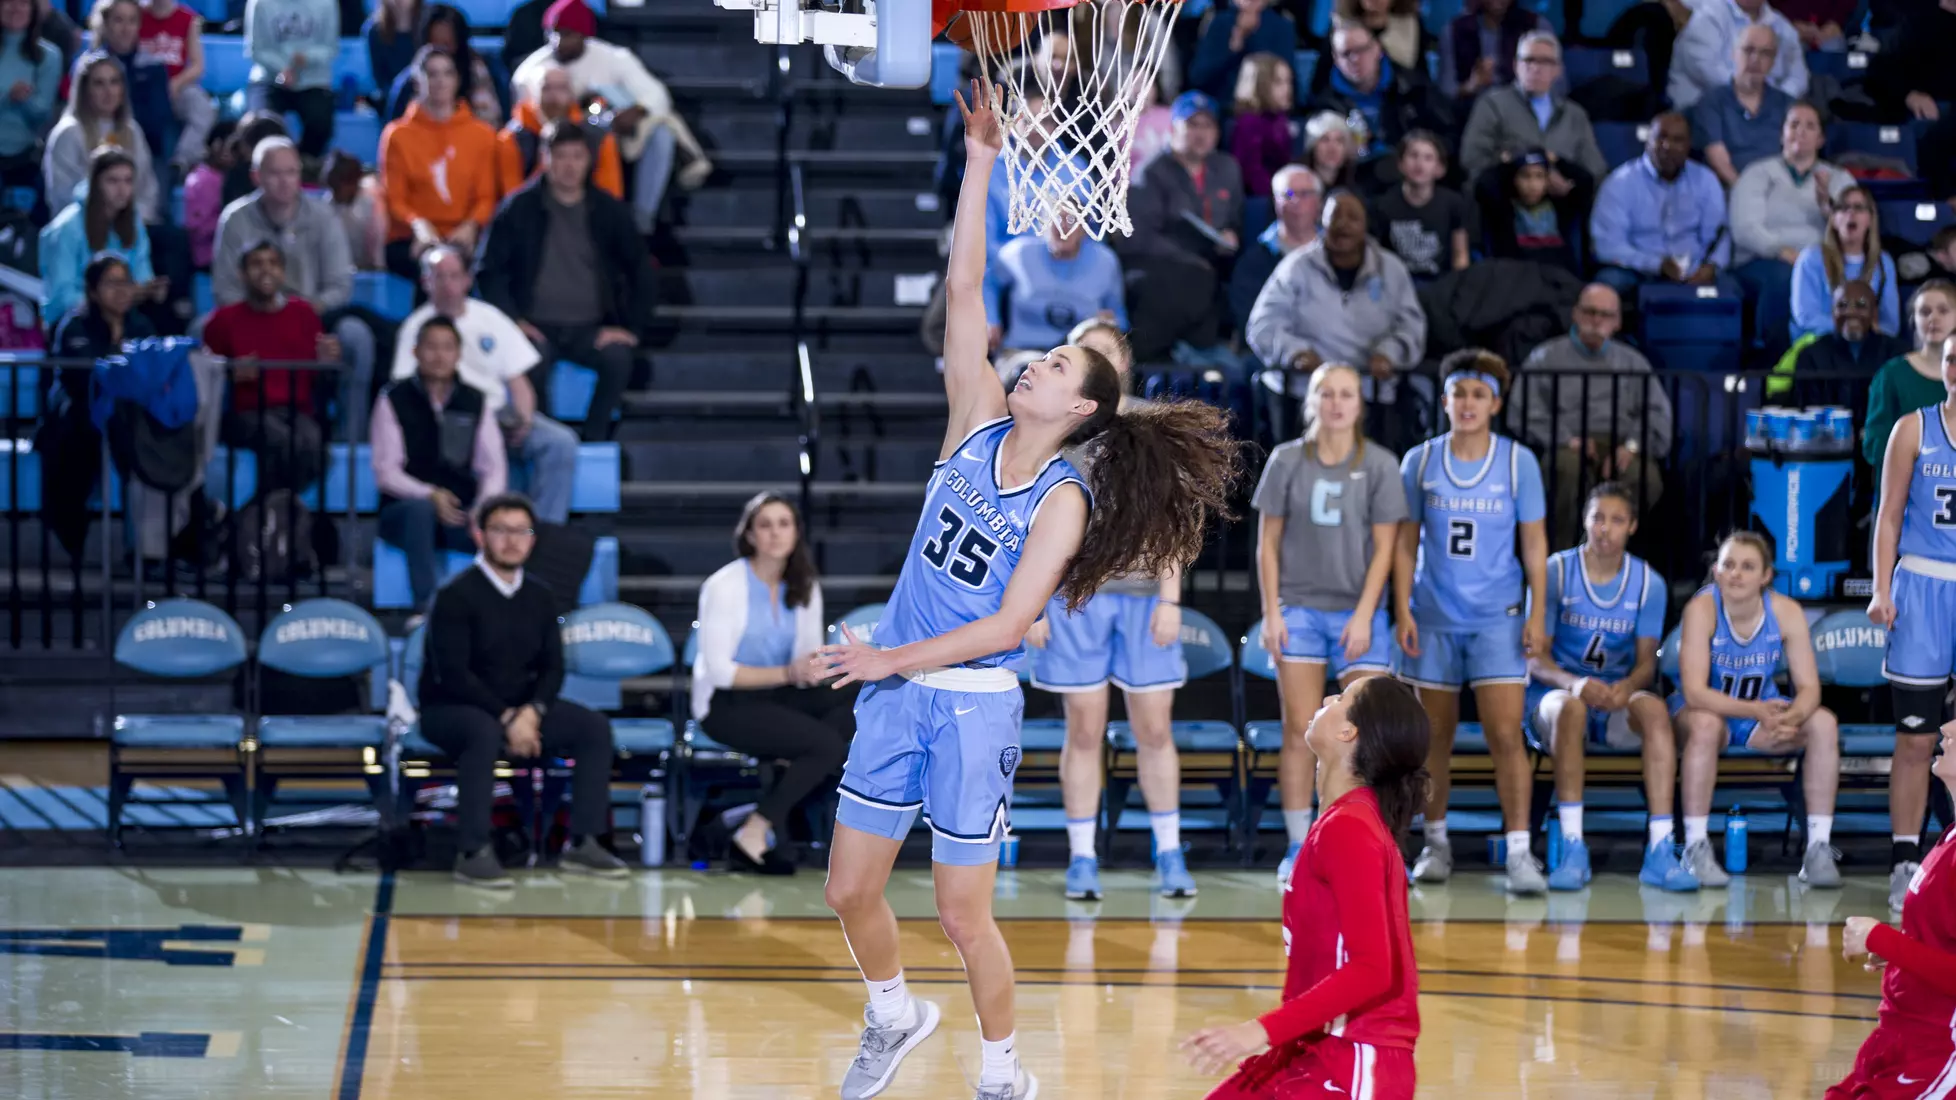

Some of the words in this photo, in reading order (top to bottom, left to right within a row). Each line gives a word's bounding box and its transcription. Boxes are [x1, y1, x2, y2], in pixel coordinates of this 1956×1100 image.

[1922, 463, 1956, 478] COL
[945, 468, 1021, 552] COLUMBIA
[1310, 478, 1342, 526] C
[920, 502, 1000, 589] 35
[1446, 516, 1476, 560] 2
[134, 616, 227, 642] COLUMBIA
[276, 616, 369, 643] COLUMBIA
[562, 619, 654, 645] COLUMBIA
[1815, 626, 1886, 652] COLUMB
[1583, 632, 1606, 673] 4
[1721, 672, 1765, 700] 10
